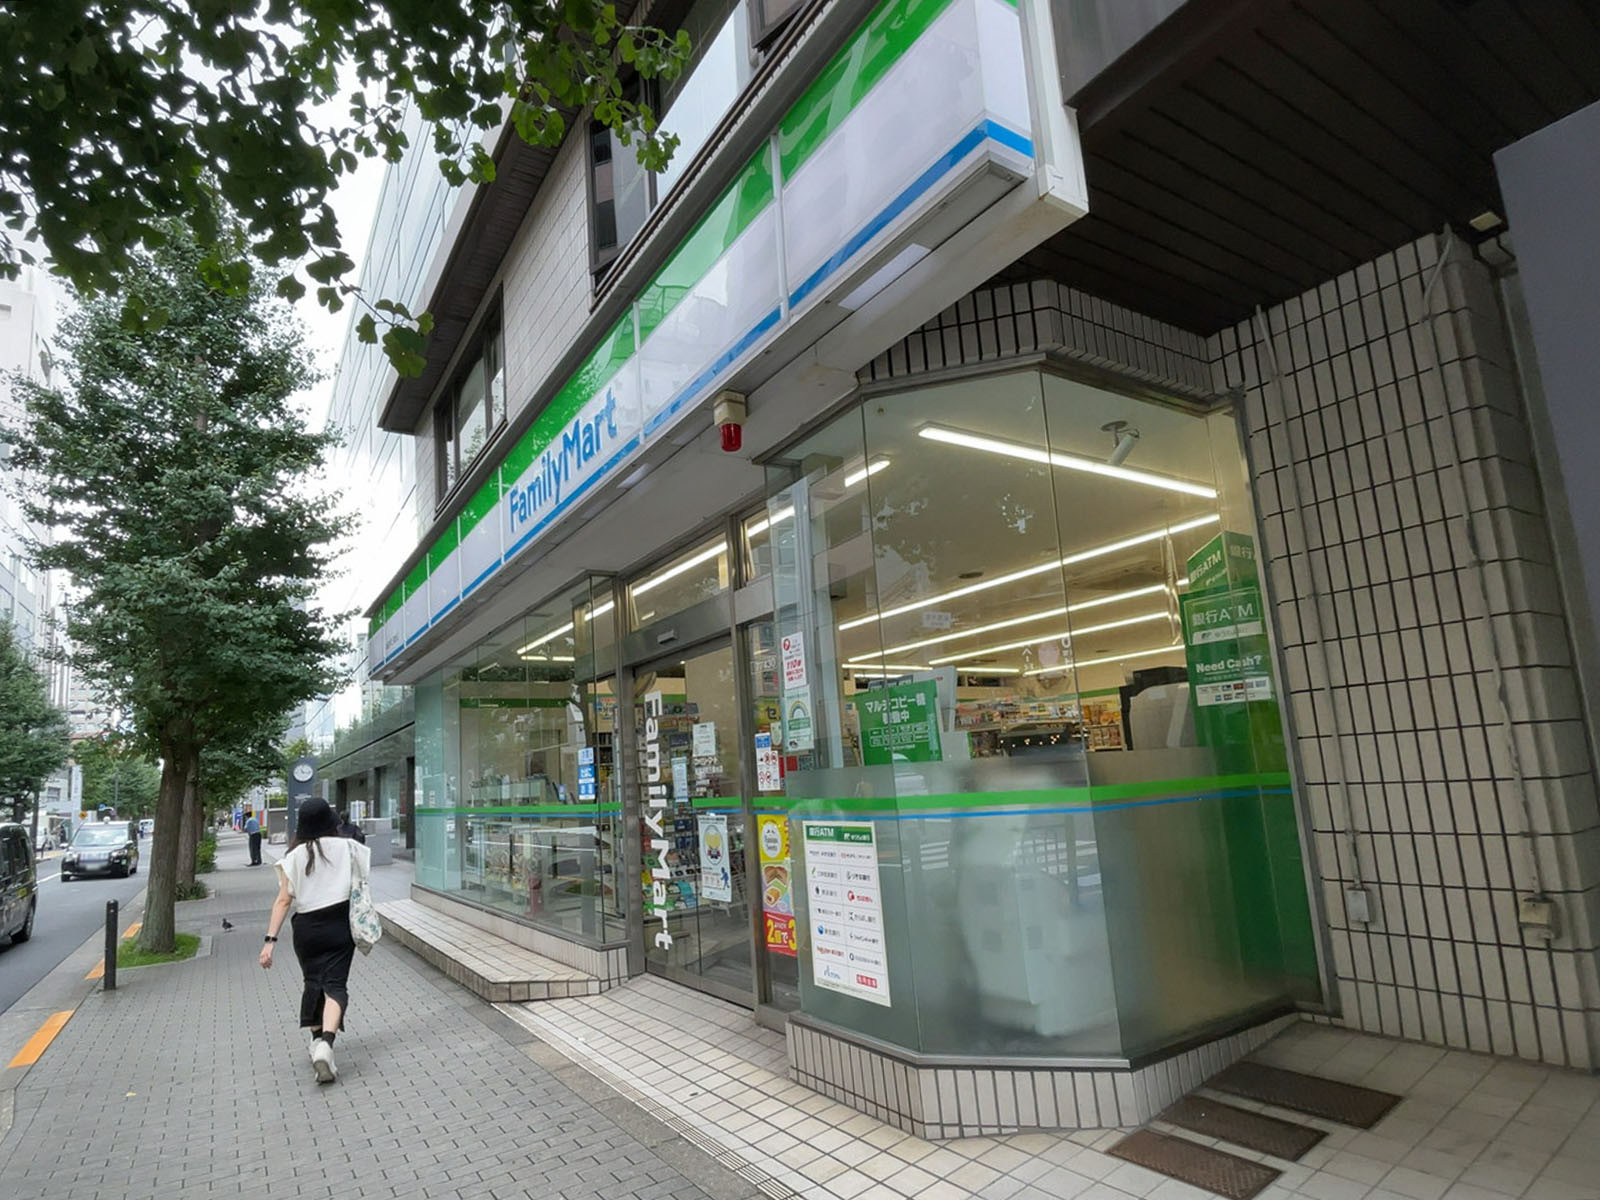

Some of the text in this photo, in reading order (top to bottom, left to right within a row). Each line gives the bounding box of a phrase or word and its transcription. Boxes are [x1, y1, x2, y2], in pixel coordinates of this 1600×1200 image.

[509, 386, 618, 533] FamilyMart
[1196, 660, 1225, 673] Need
[644, 690, 673, 950] FamilyMart
